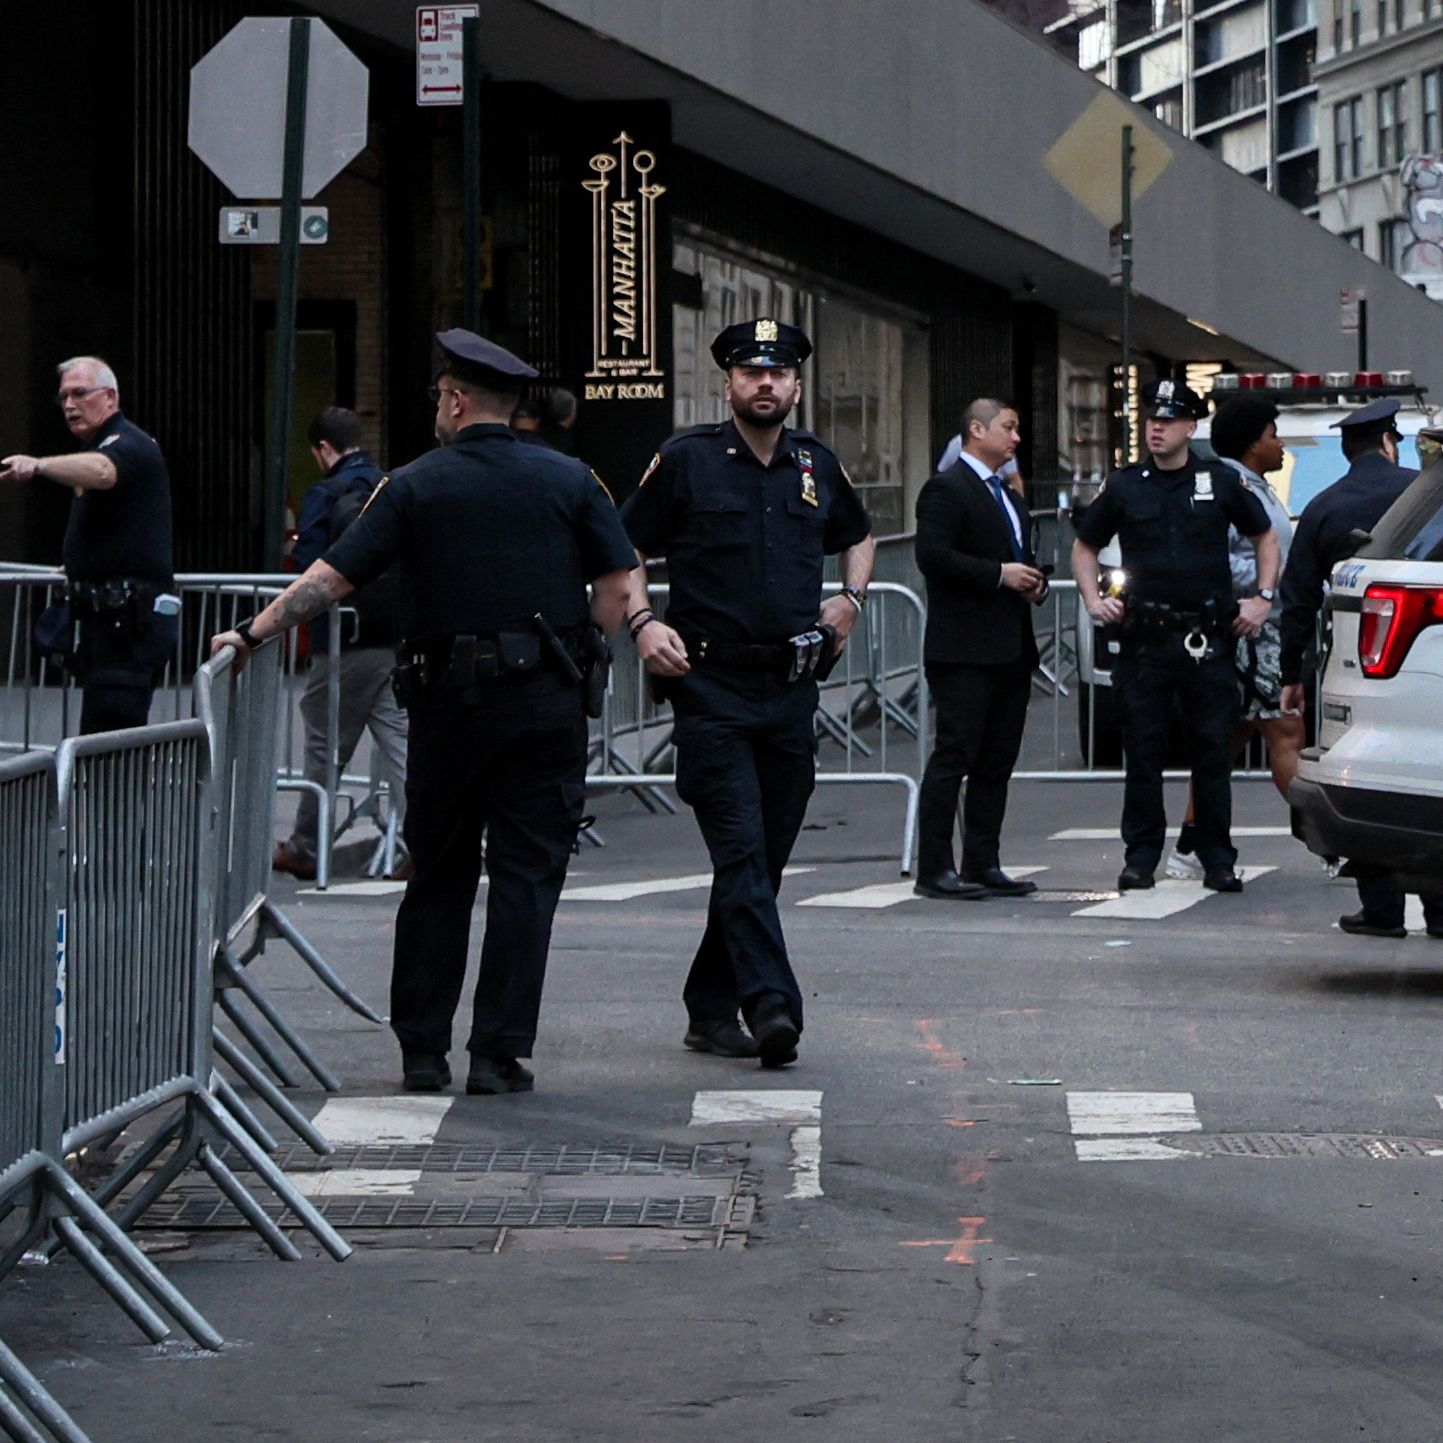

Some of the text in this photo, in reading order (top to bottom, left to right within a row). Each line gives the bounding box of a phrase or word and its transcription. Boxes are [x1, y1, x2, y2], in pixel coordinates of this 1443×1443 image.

[597, 359, 651, 369] RESTAURANT
[619, 368, 639, 377] BAR
[584, 383, 665, 400] BAY ROOM
